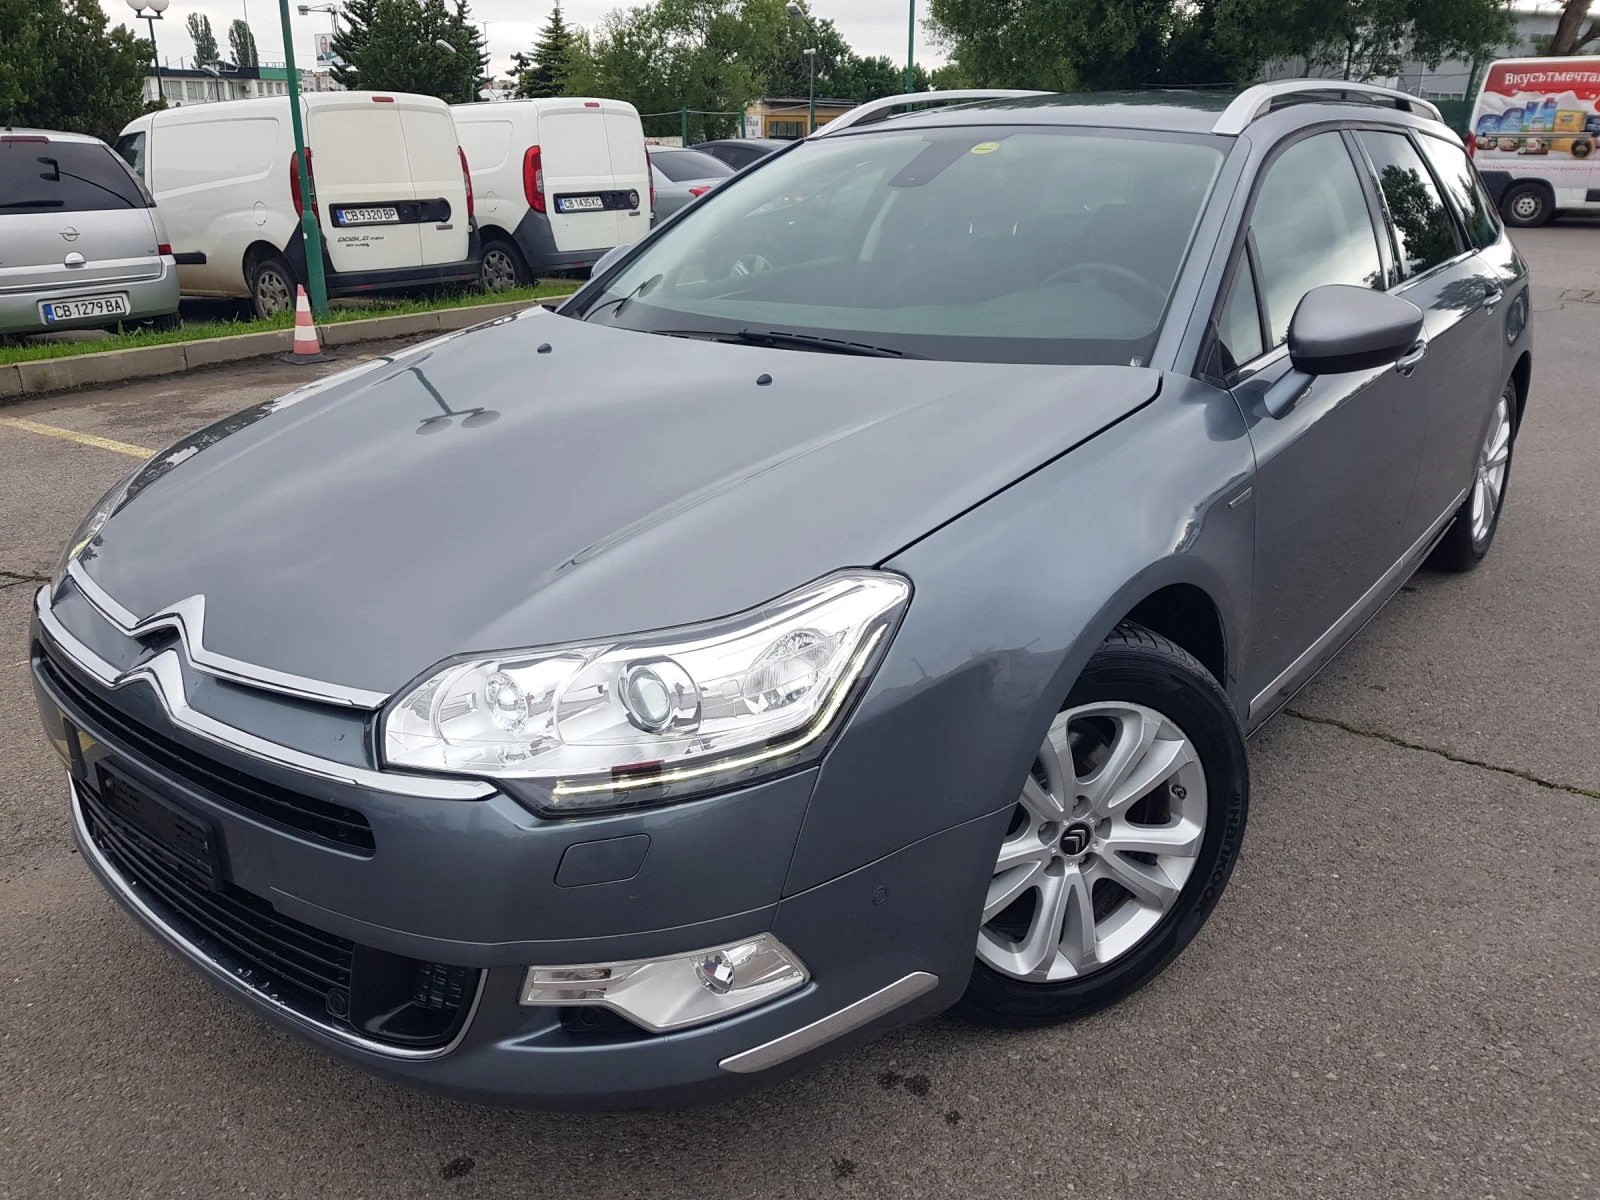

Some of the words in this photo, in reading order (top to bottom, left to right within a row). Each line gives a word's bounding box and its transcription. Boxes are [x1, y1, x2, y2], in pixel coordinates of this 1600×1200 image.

[359, 210, 383, 220] 9320
[54, 306, 72, 319] CB
[75, 302, 104, 316] 1279
[105, 300, 122, 314] BA
